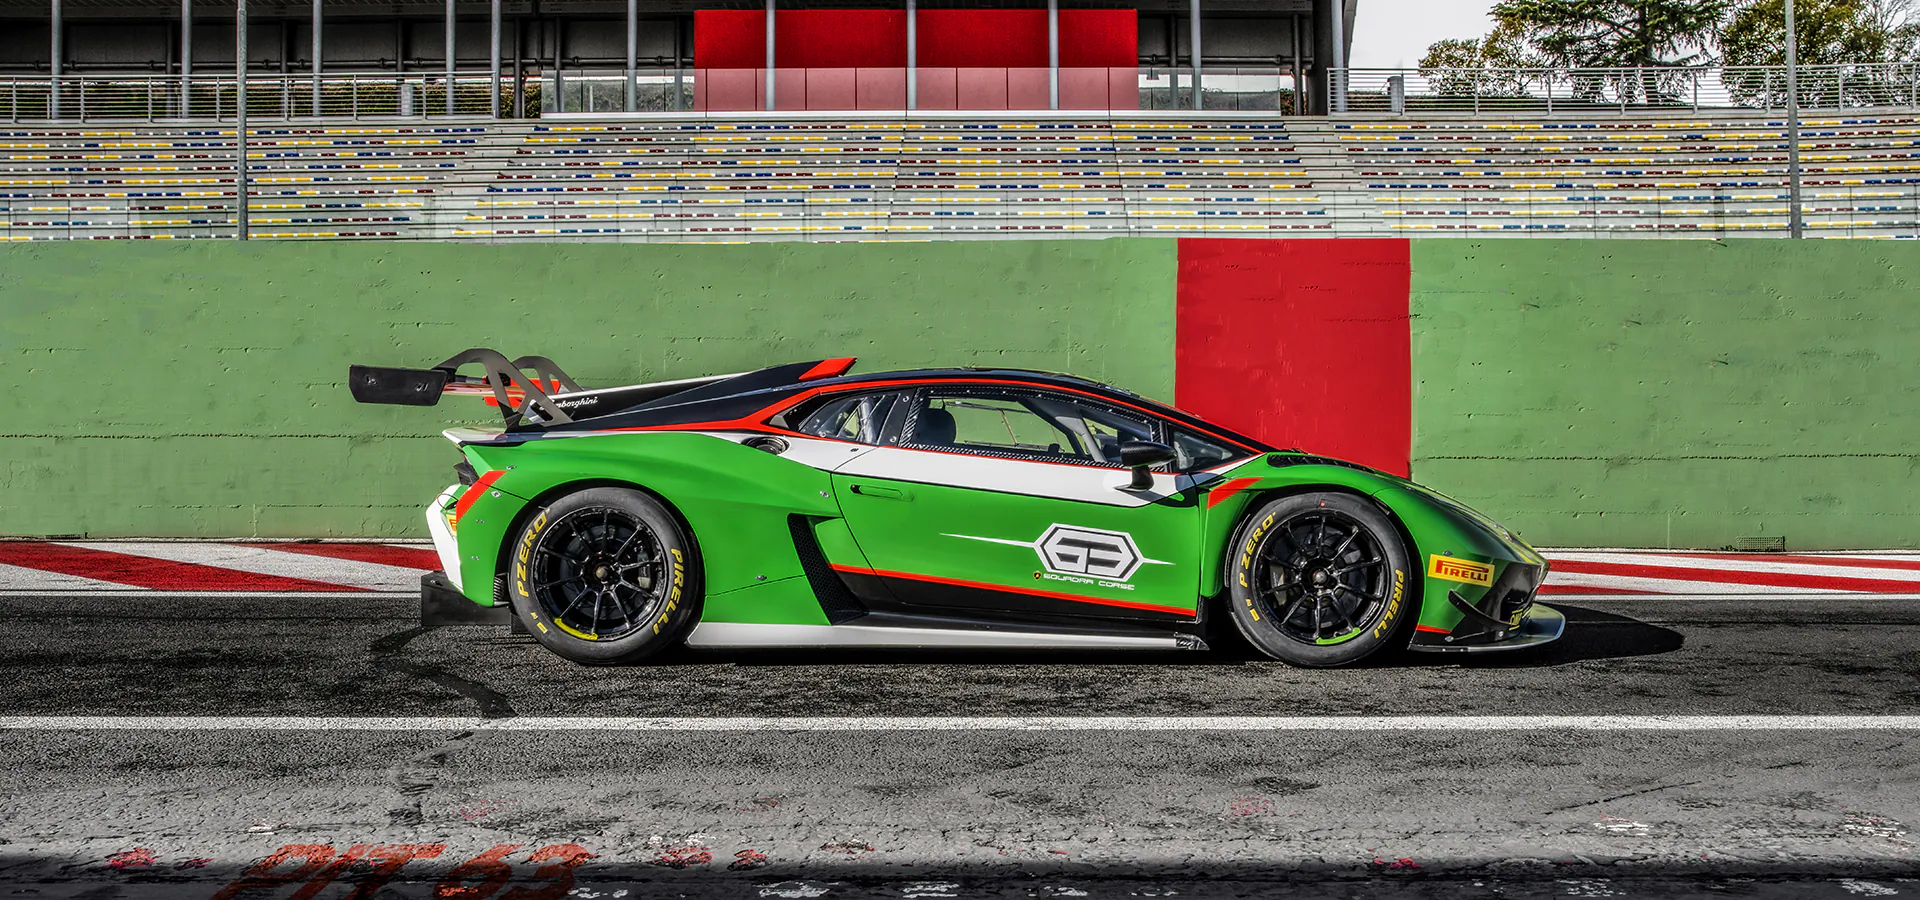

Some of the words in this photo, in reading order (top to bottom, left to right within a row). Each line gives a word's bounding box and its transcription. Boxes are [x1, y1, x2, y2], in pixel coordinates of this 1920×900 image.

[653, 548, 684, 635] PIRELLI
[1043, 573, 1094, 585] SQUADRA
[1098, 579, 1135, 591] CORSE
[1435, 559, 1490, 582] PIRELLI
[1373, 568, 1405, 639] PIRELLI
